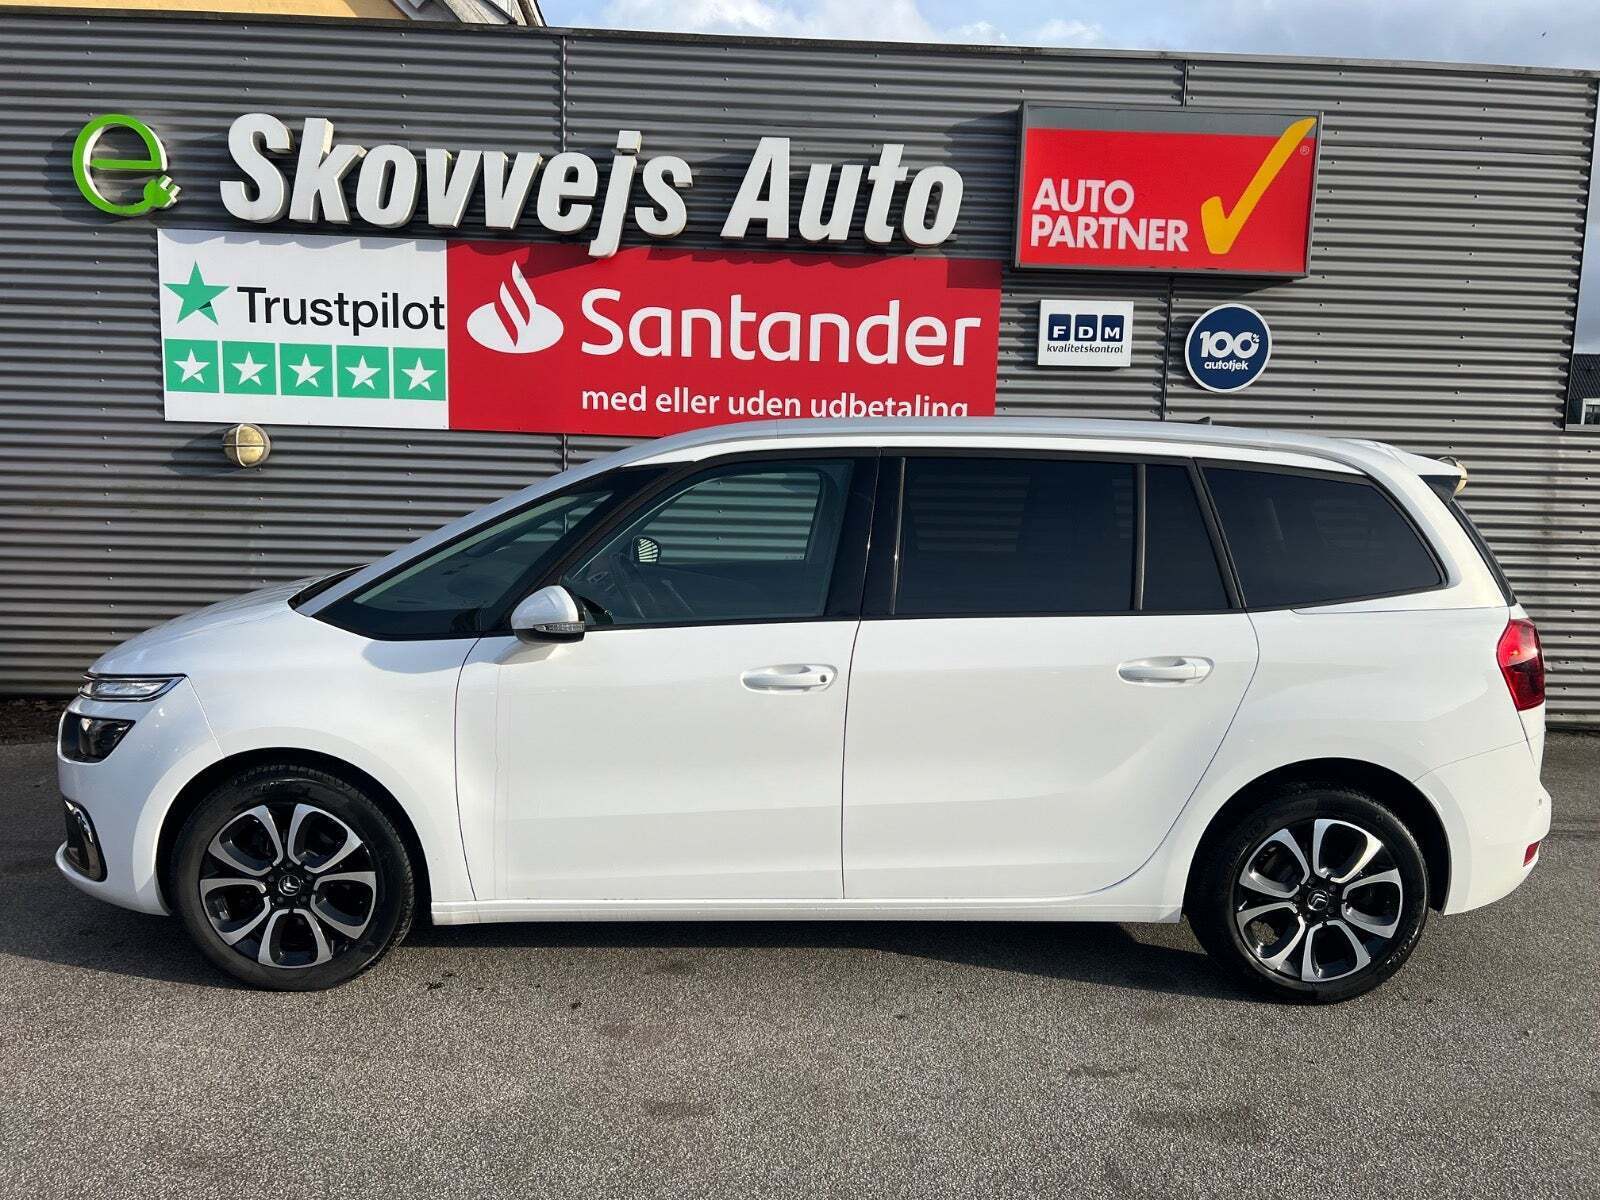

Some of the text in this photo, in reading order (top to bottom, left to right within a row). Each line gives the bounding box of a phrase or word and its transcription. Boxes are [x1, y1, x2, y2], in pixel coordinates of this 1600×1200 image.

[219, 112, 964, 257] Skovvejs Auto
[1032, 178, 1134, 214] AUTO
[1030, 214, 1189, 252] PARTNER
[237, 286, 445, 336] Trustpilot
[581, 288, 981, 366] Santander
[1047, 344, 1123, 354] kvalitetskontrol
[1052, 325, 1120, 340] FDM
[1204, 360, 1249, 373] autotjek
[581, 386, 647, 413] med
[655, 388, 720, 415] eller
[728, 391, 801, 417] uden
